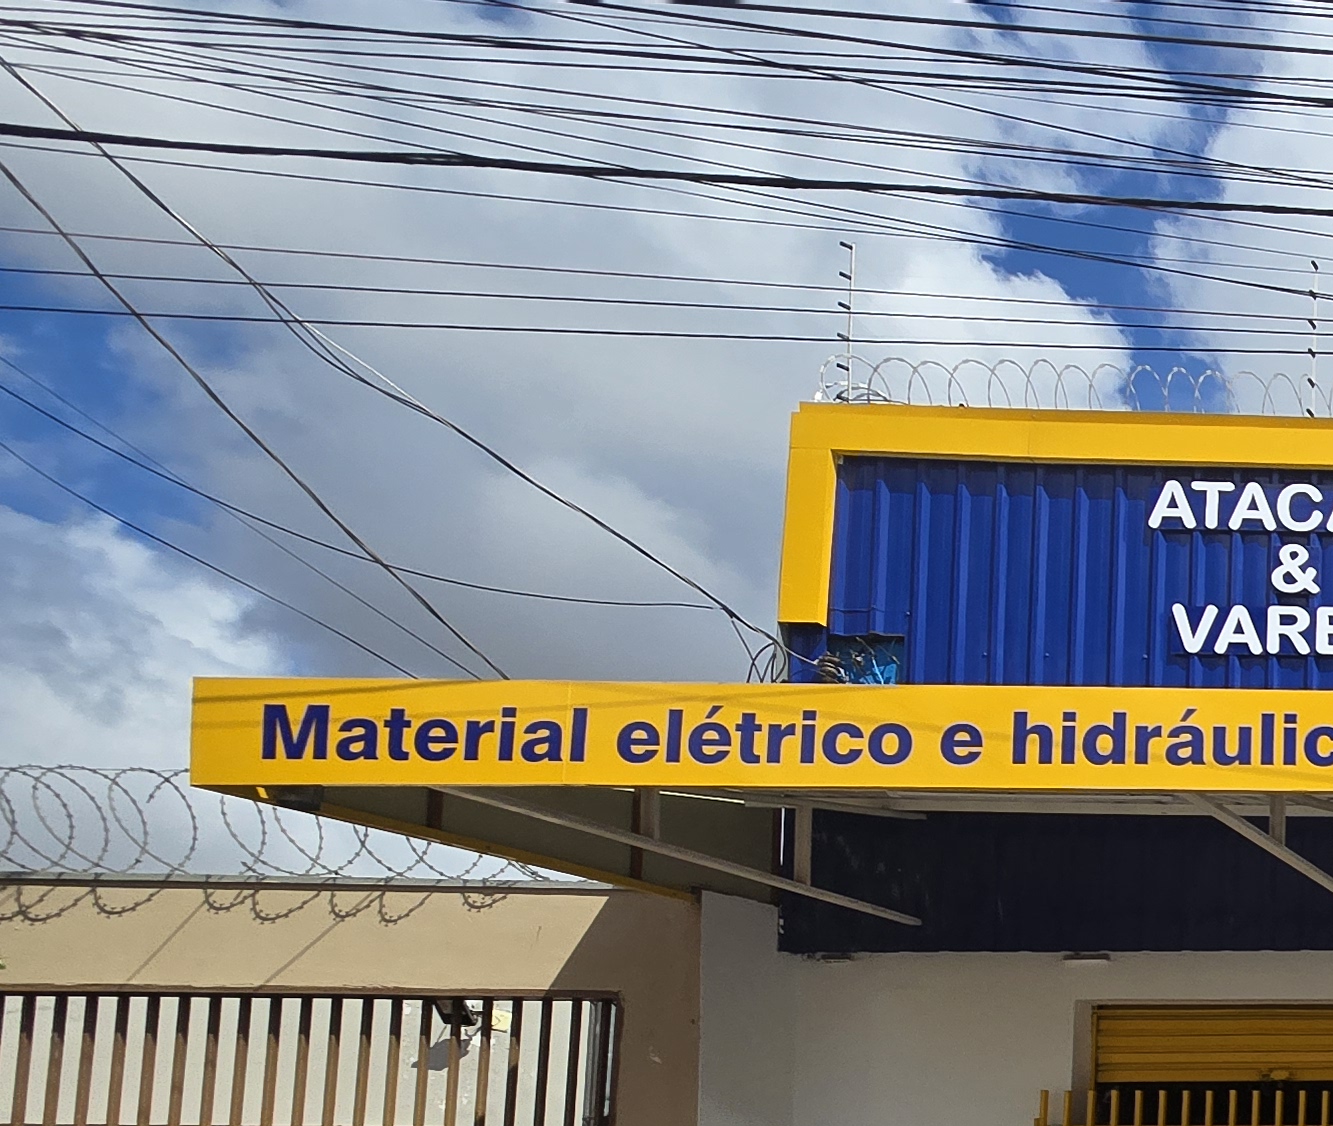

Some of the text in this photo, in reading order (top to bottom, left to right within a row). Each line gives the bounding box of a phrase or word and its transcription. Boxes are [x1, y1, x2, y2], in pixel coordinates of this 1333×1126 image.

[1271, 543, 1320, 594] &
[261, 703, 587, 762] Material
[617, 705, 913, 765] elétrico
[940, 723, 983, 766] e
